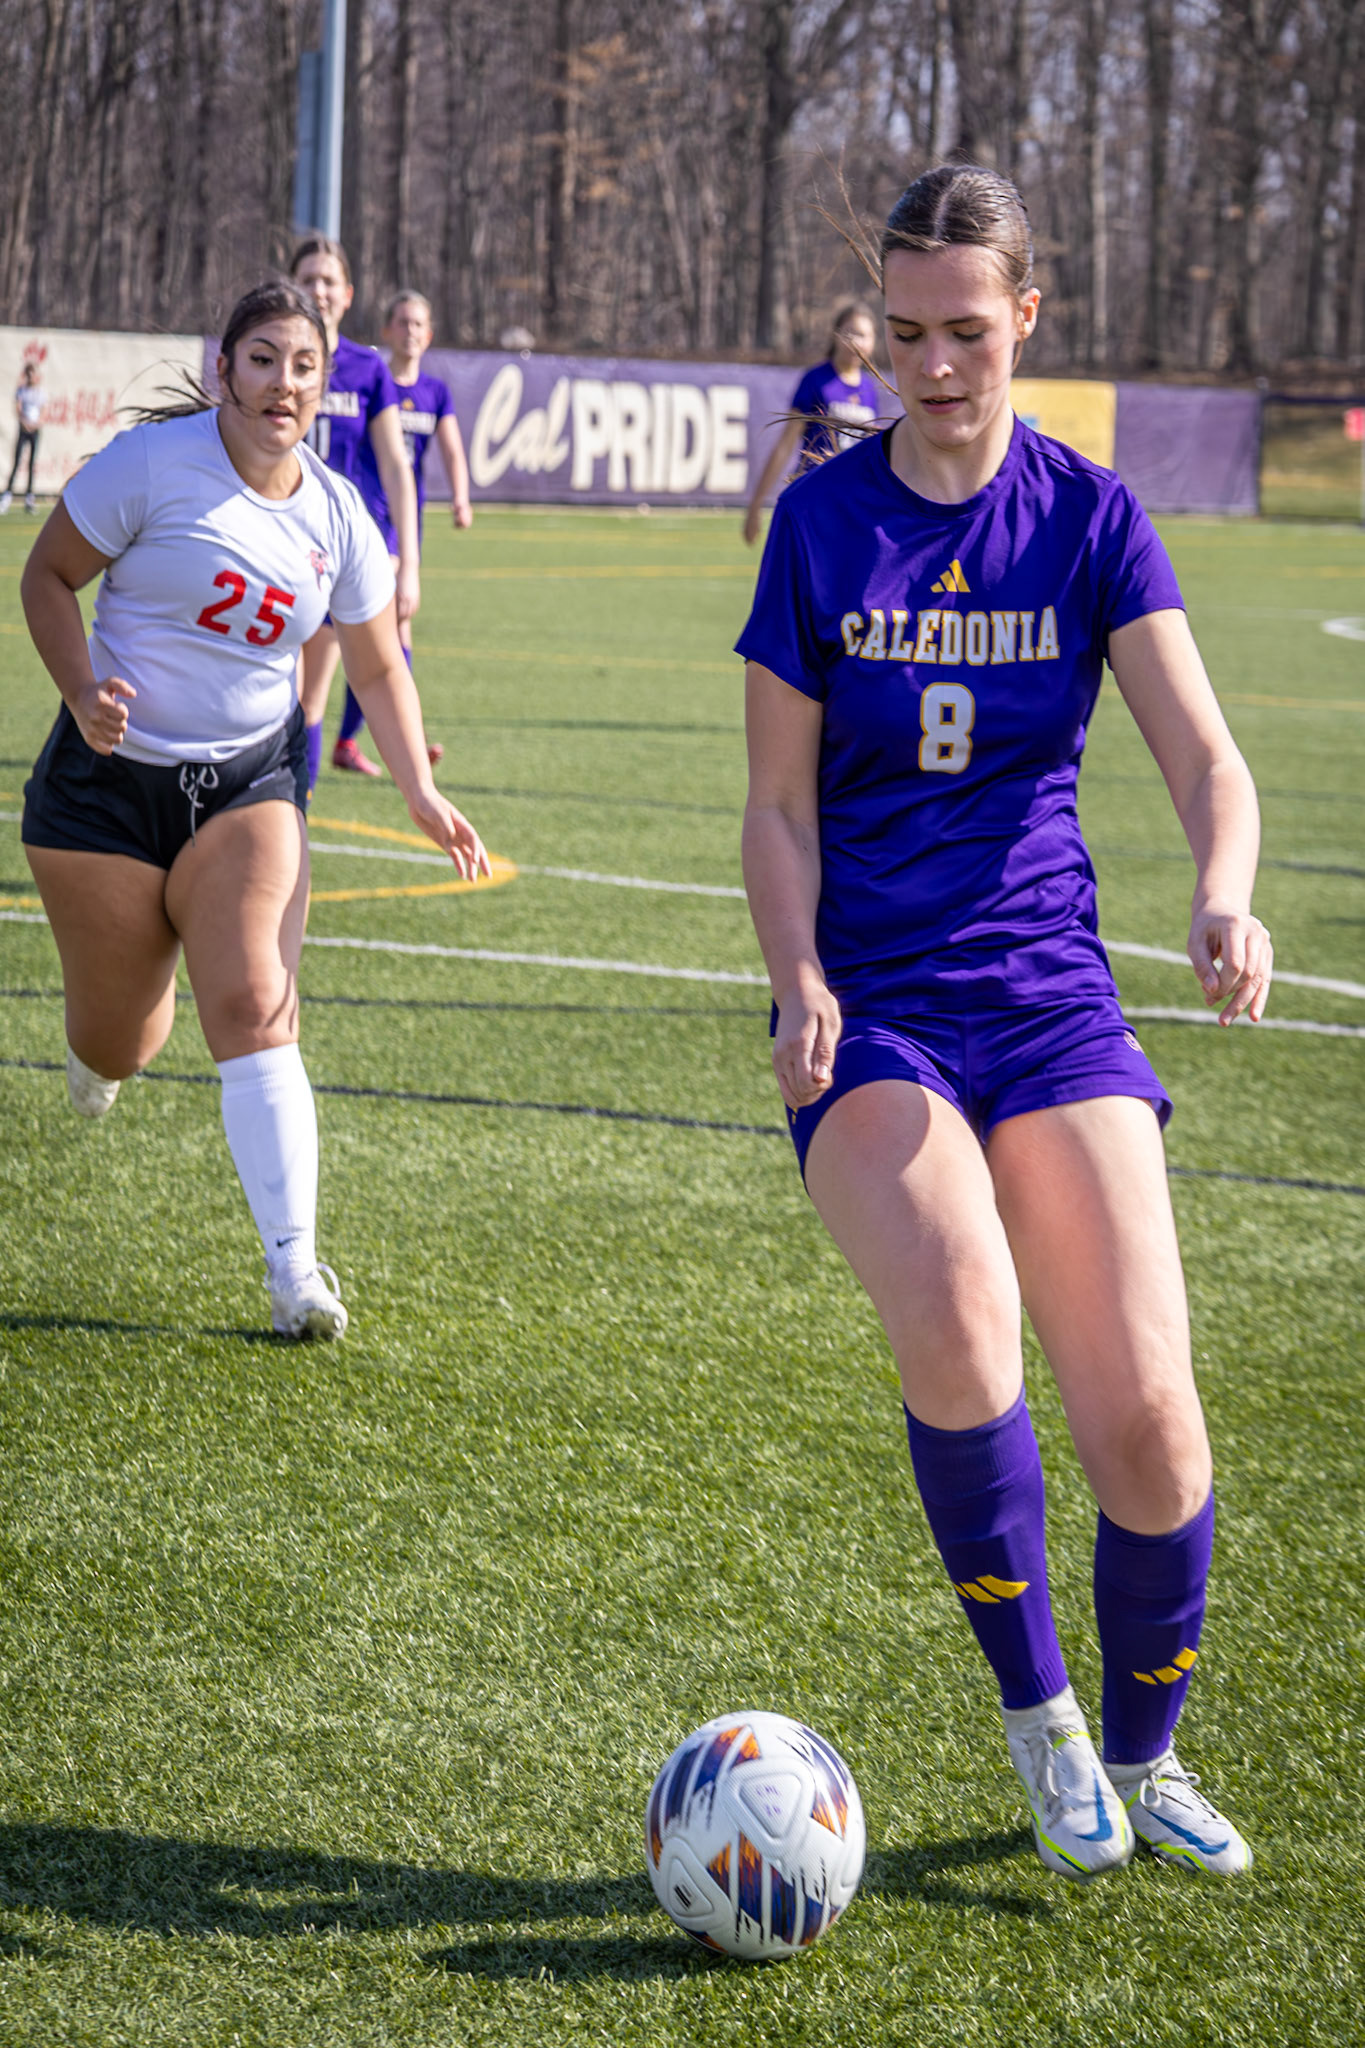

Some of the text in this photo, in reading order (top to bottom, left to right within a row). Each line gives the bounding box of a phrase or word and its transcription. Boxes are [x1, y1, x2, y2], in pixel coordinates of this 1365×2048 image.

[469, 363, 749, 494] Cal PRIDE
[196, 569, 296, 647] 25
[840, 605, 1060, 666] CALEDONIA
[918, 682, 976, 774] 8
